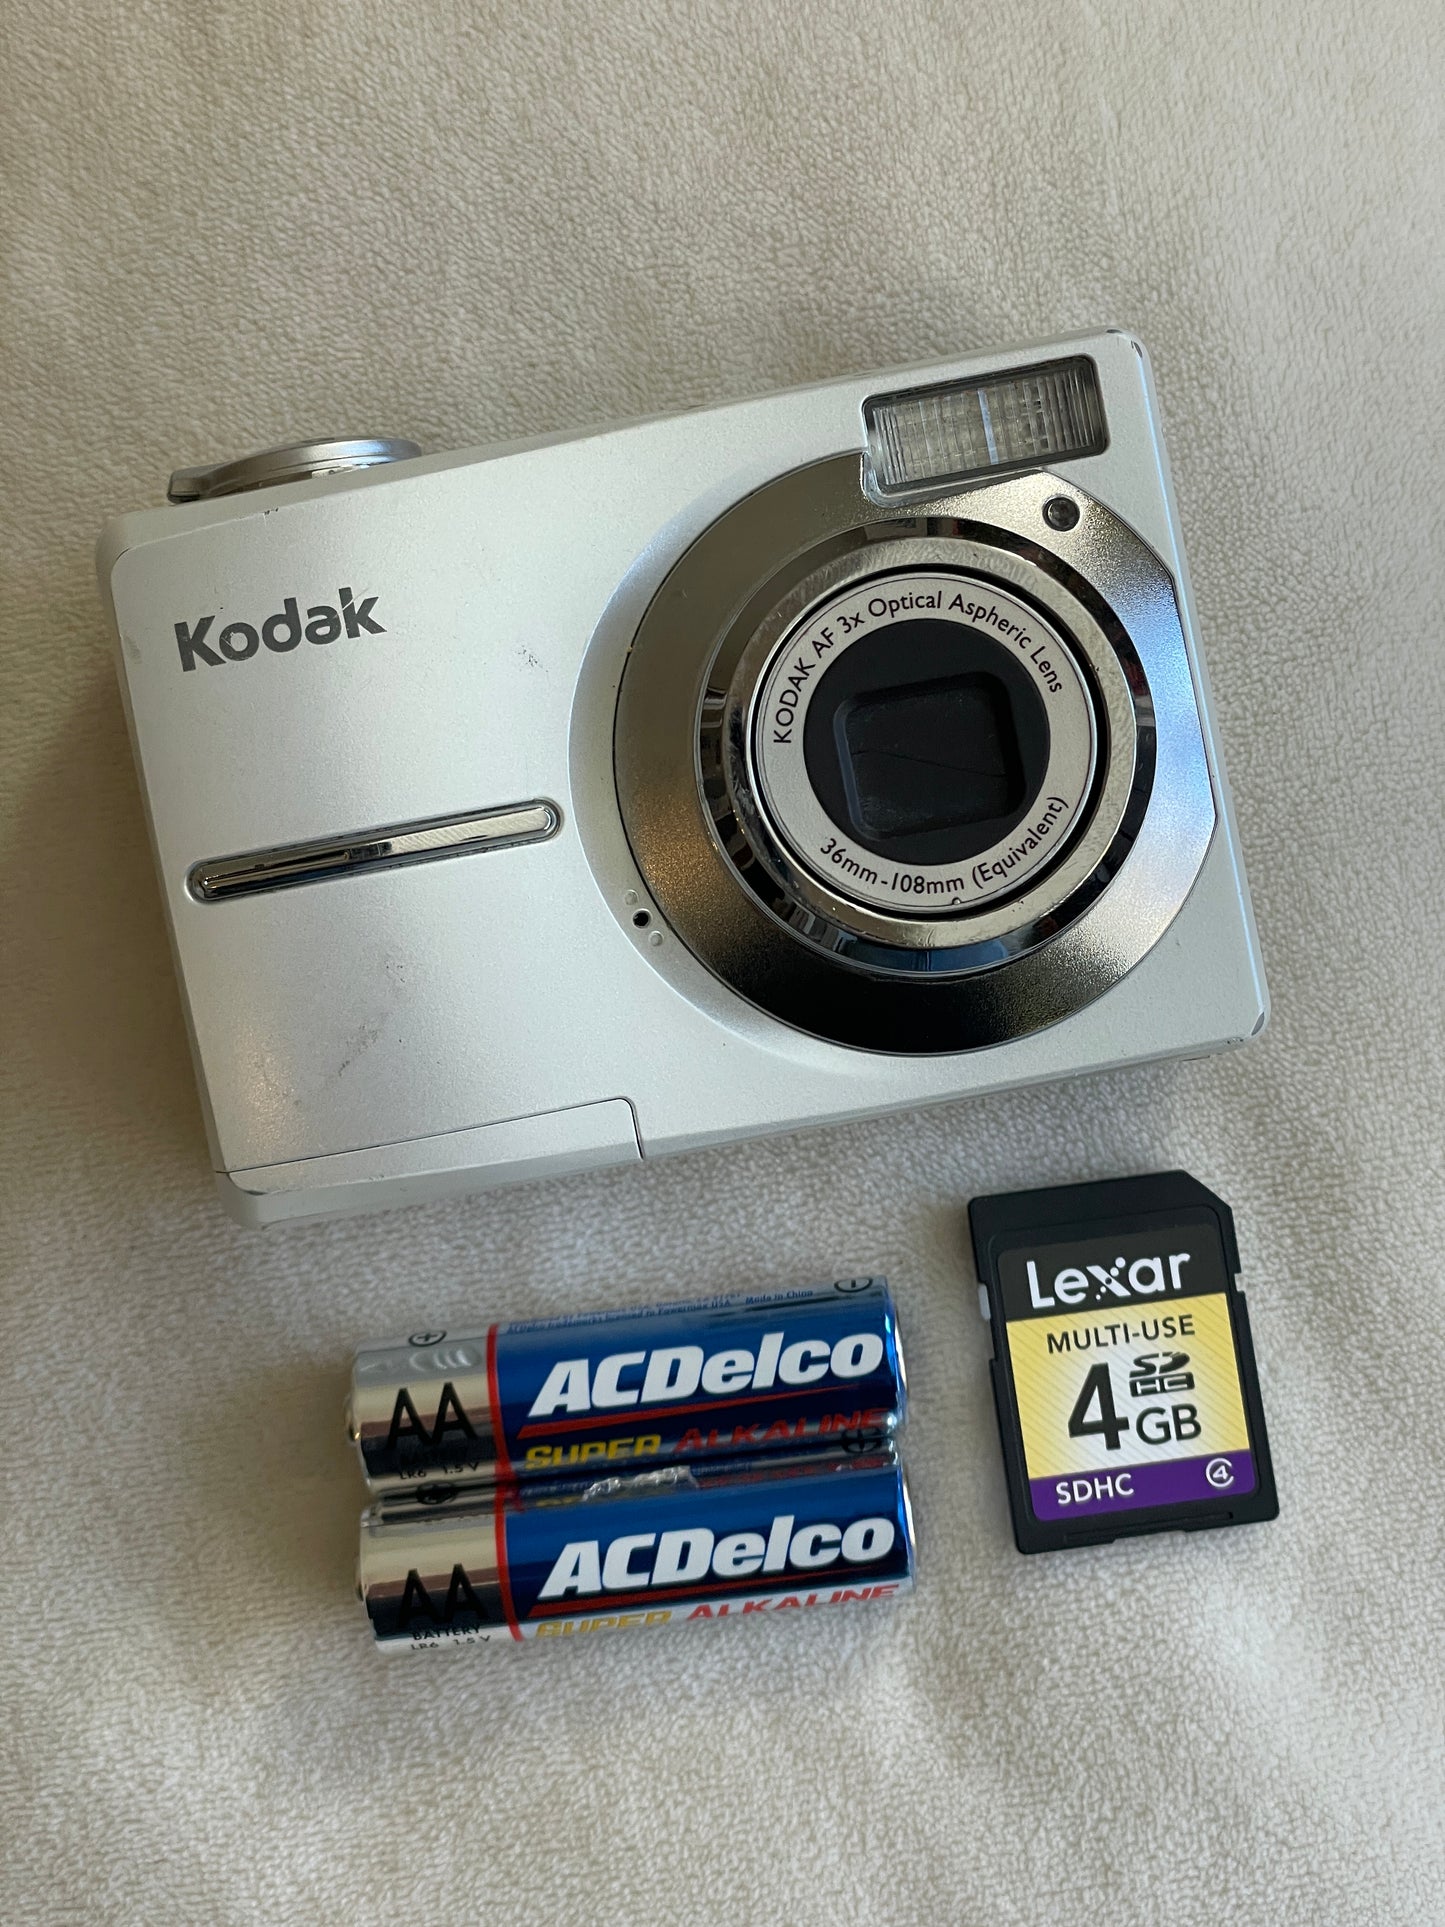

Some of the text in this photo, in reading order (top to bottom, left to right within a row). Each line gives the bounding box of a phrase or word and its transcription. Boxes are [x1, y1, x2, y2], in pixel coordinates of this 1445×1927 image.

[174, 586, 388, 672] Kodak
[773, 590, 1063, 744] KODAK AF 3x Optical Aspheric Lens
[972, 796, 1070, 889] (Equivalent)
[1026, 1252, 1191, 1309] Lexar
[1046, 1314, 1196, 1354] MULTI-USE
[528, 1332, 884, 1419] ACDelco
[1067, 1362, 1202, 1451] 4 GB
[385, 1381, 479, 1450] AA
[525, 1433, 662, 1471] SUPER
[672, 1407, 890, 1454] ALKALINE
[1055, 1473, 1135, 1506] SDHC
[537, 1515, 895, 1601] ACDelco
[397, 1562, 490, 1629] AA
[534, 1583, 901, 1638] SUPER ALKALINE
[410, 1642, 440, 1651] LR6
[411, 1623, 481, 1641] BATTERY
